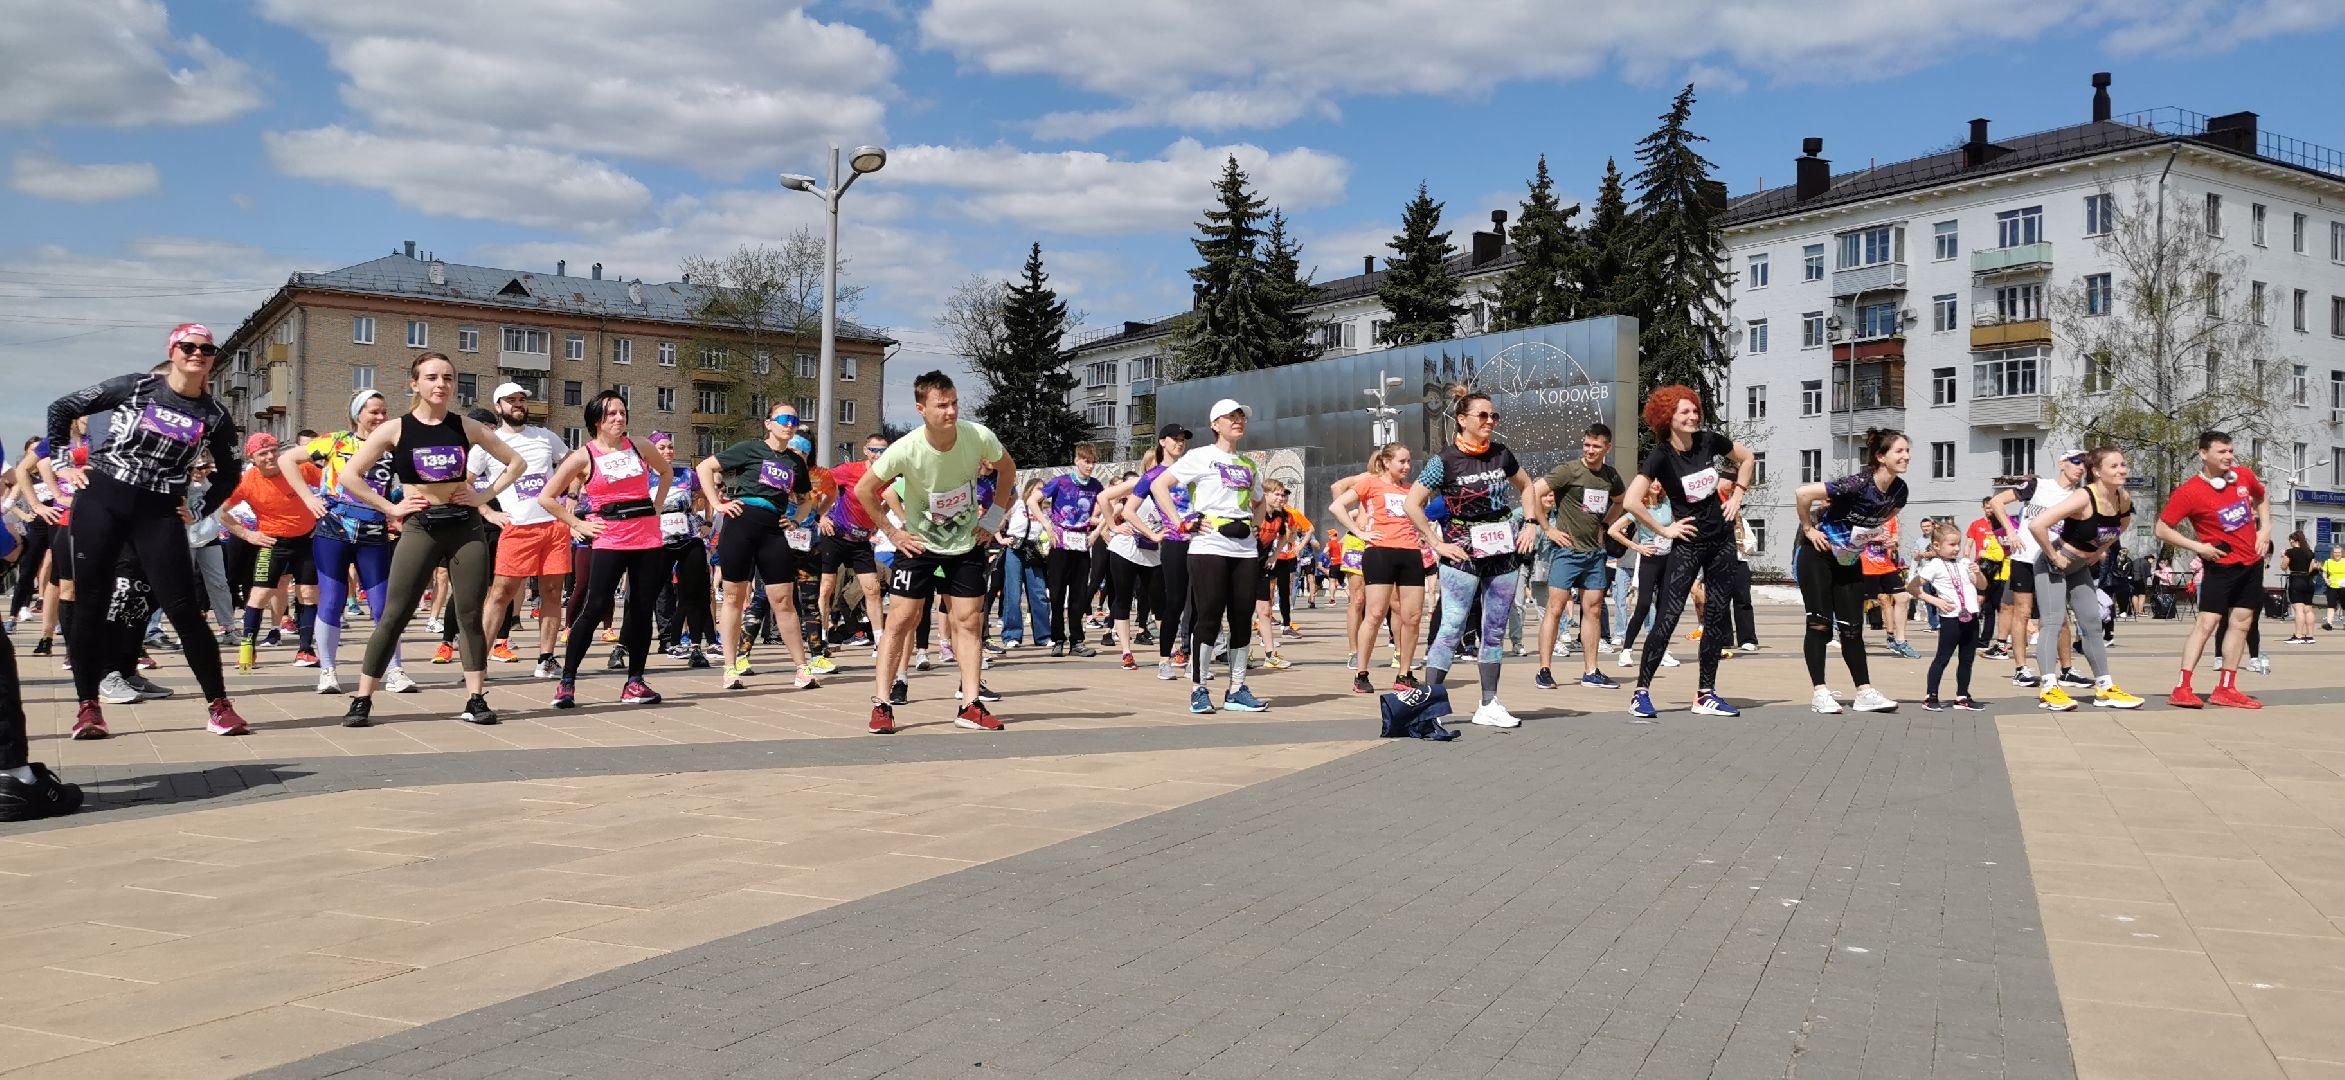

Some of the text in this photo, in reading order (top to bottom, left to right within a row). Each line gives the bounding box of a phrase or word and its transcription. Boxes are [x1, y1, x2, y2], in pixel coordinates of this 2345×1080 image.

[1539, 381, 1609, 407] Королёв
[155, 407, 193, 427] 1379
[421, 453, 457, 467] 1394
[767, 465, 789, 480] 1370
[518, 478, 544, 490] 1409
[1688, 475, 1715, 490] 5209
[936, 492, 967, 509] 5223
[1480, 530, 1505, 543] 5116
[893, 569, 912, 591] 24
